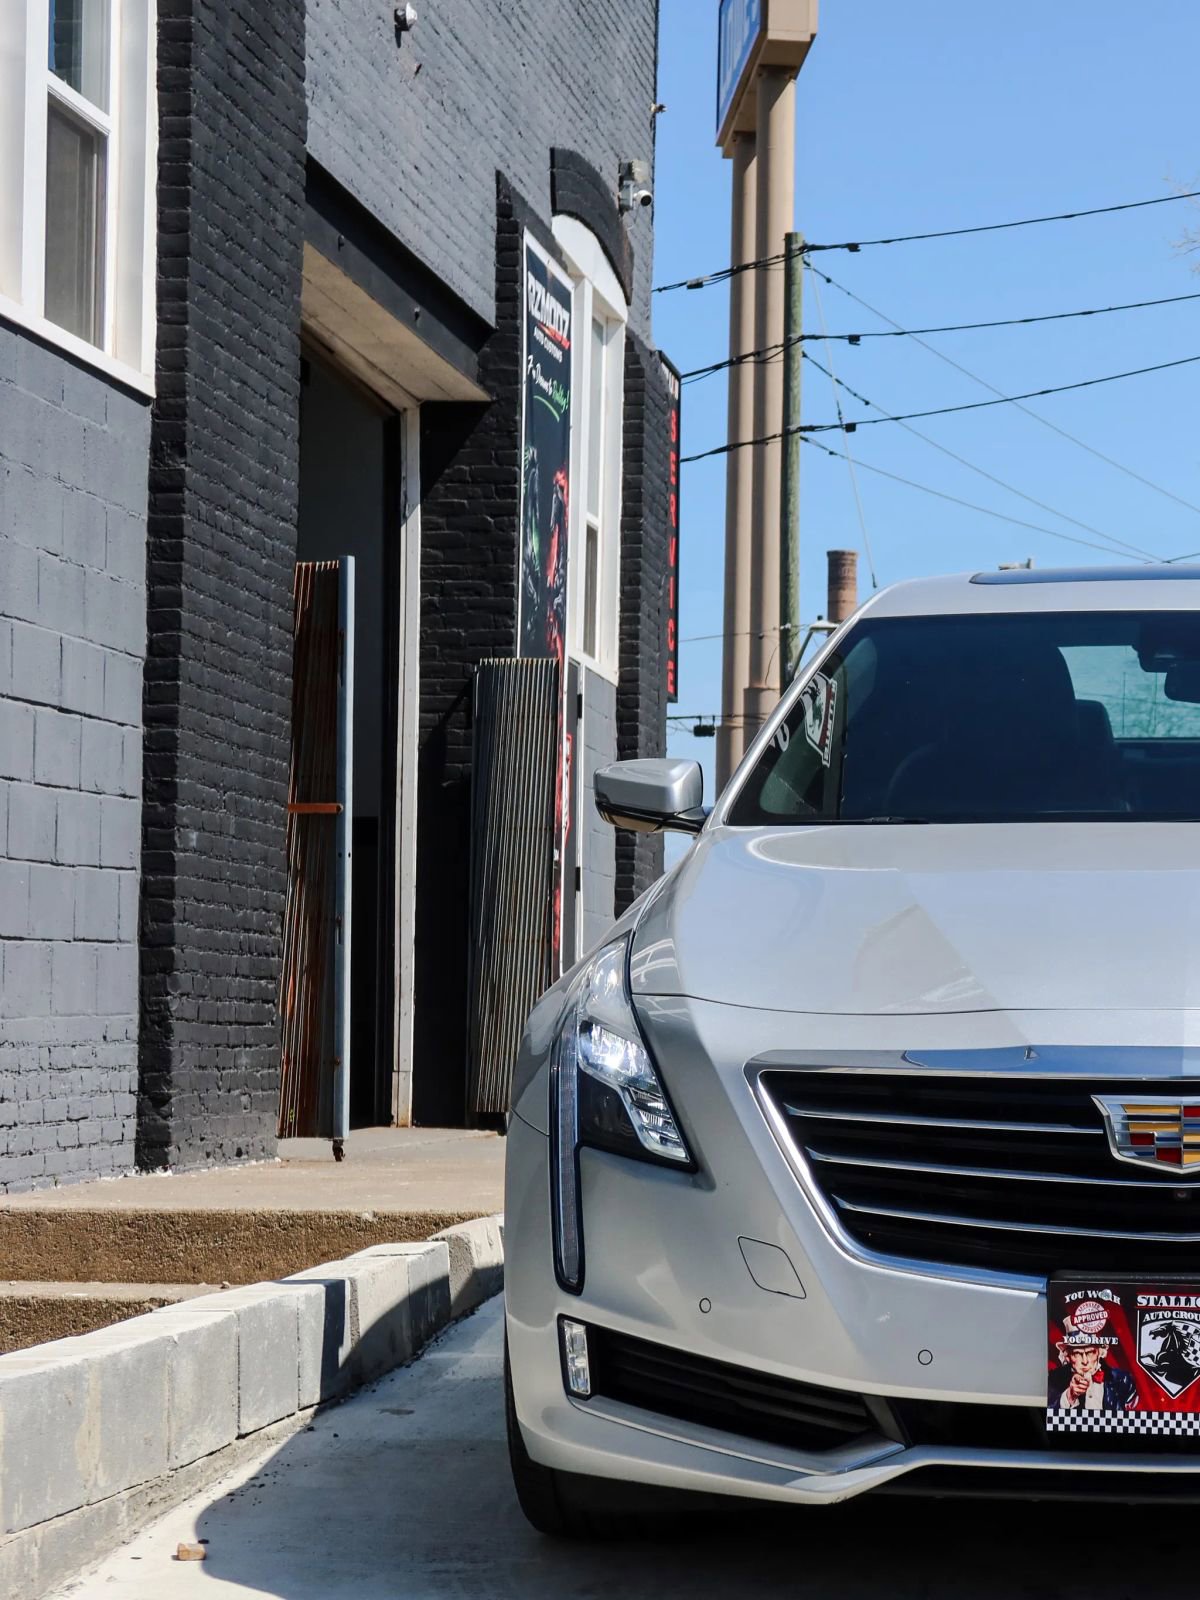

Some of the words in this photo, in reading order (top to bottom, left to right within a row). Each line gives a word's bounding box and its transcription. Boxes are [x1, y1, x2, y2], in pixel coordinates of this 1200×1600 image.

[667, 407, 678, 694] SERVICE
[1064, 1290, 1085, 1303] YOU
[1073, 1310, 1109, 1325] APPROVED
[1142, 1310, 1172, 1322] AUTO
[1062, 1335, 1081, 1344] YOU
[1084, 1336, 1119, 1345] DRIVE
